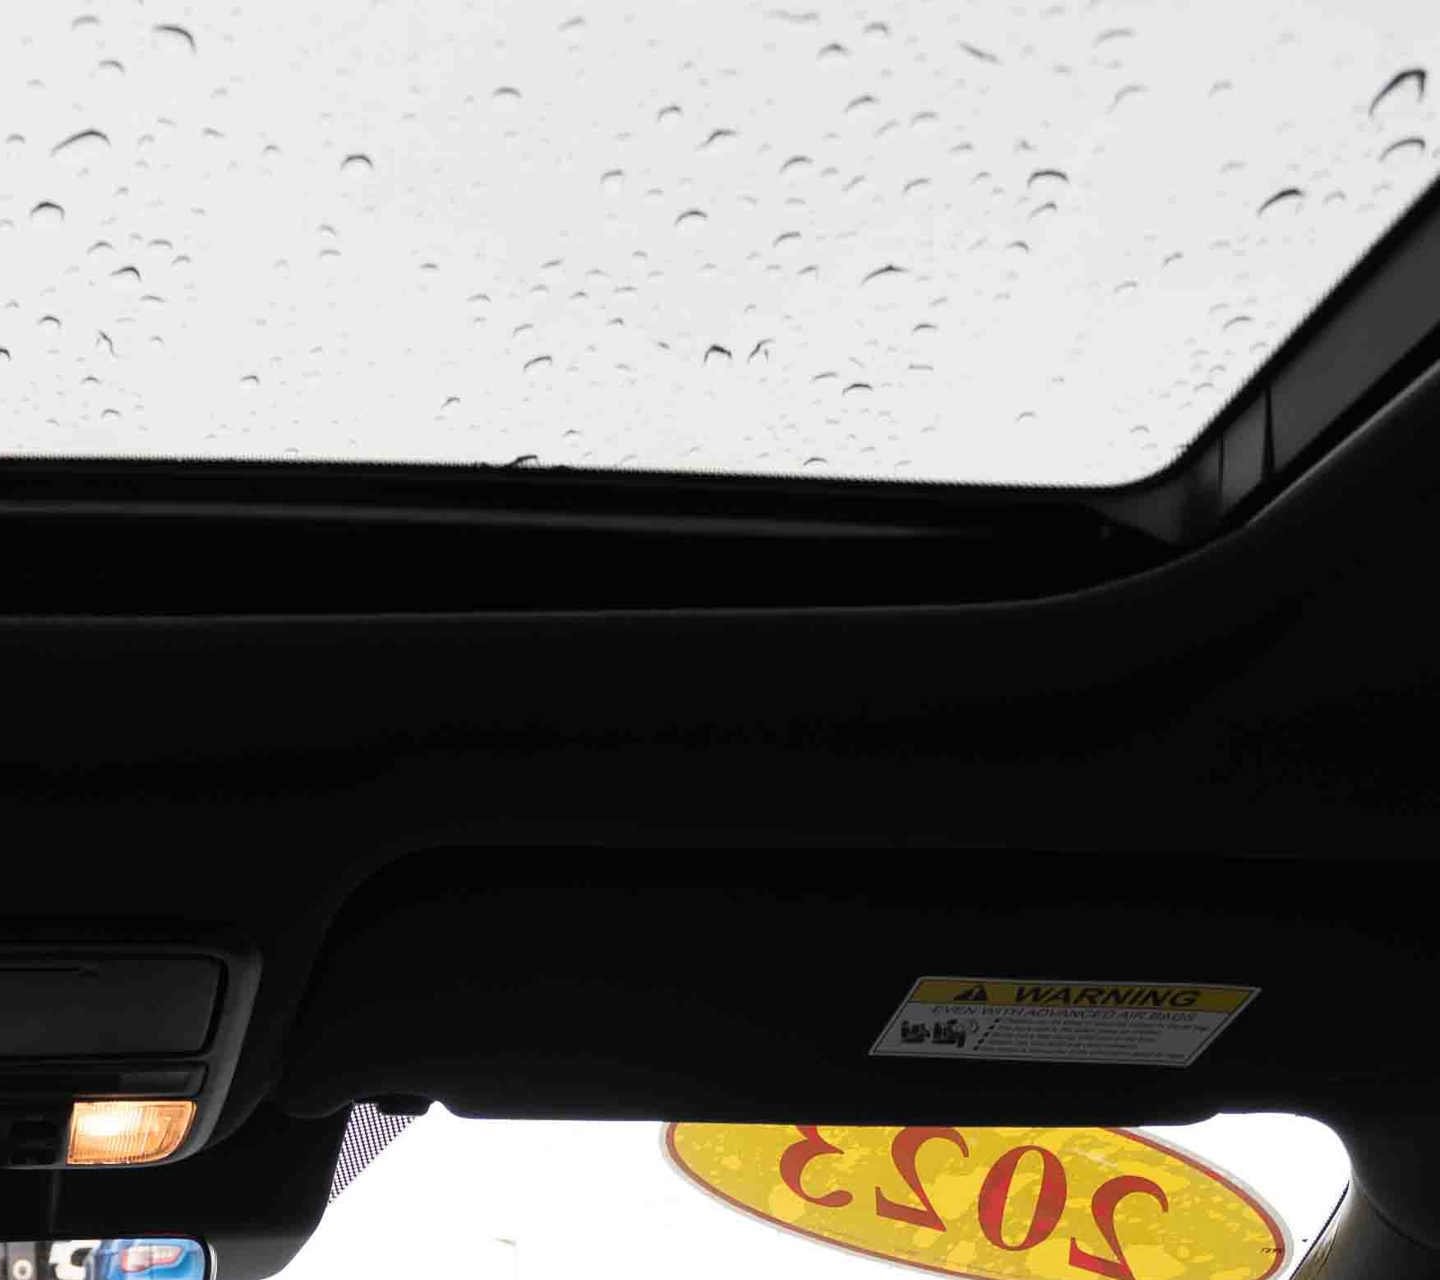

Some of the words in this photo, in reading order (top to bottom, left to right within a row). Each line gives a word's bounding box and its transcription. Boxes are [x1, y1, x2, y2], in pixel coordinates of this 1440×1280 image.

[1016, 986, 1200, 1007] WARNING
[931, 1006, 978, 1016] EVEN
[981, 1007, 1023, 1017] WITH
[1025, 1009, 1116, 1020] ADVANCED
[1119, 1011, 1146, 1021] AIR
